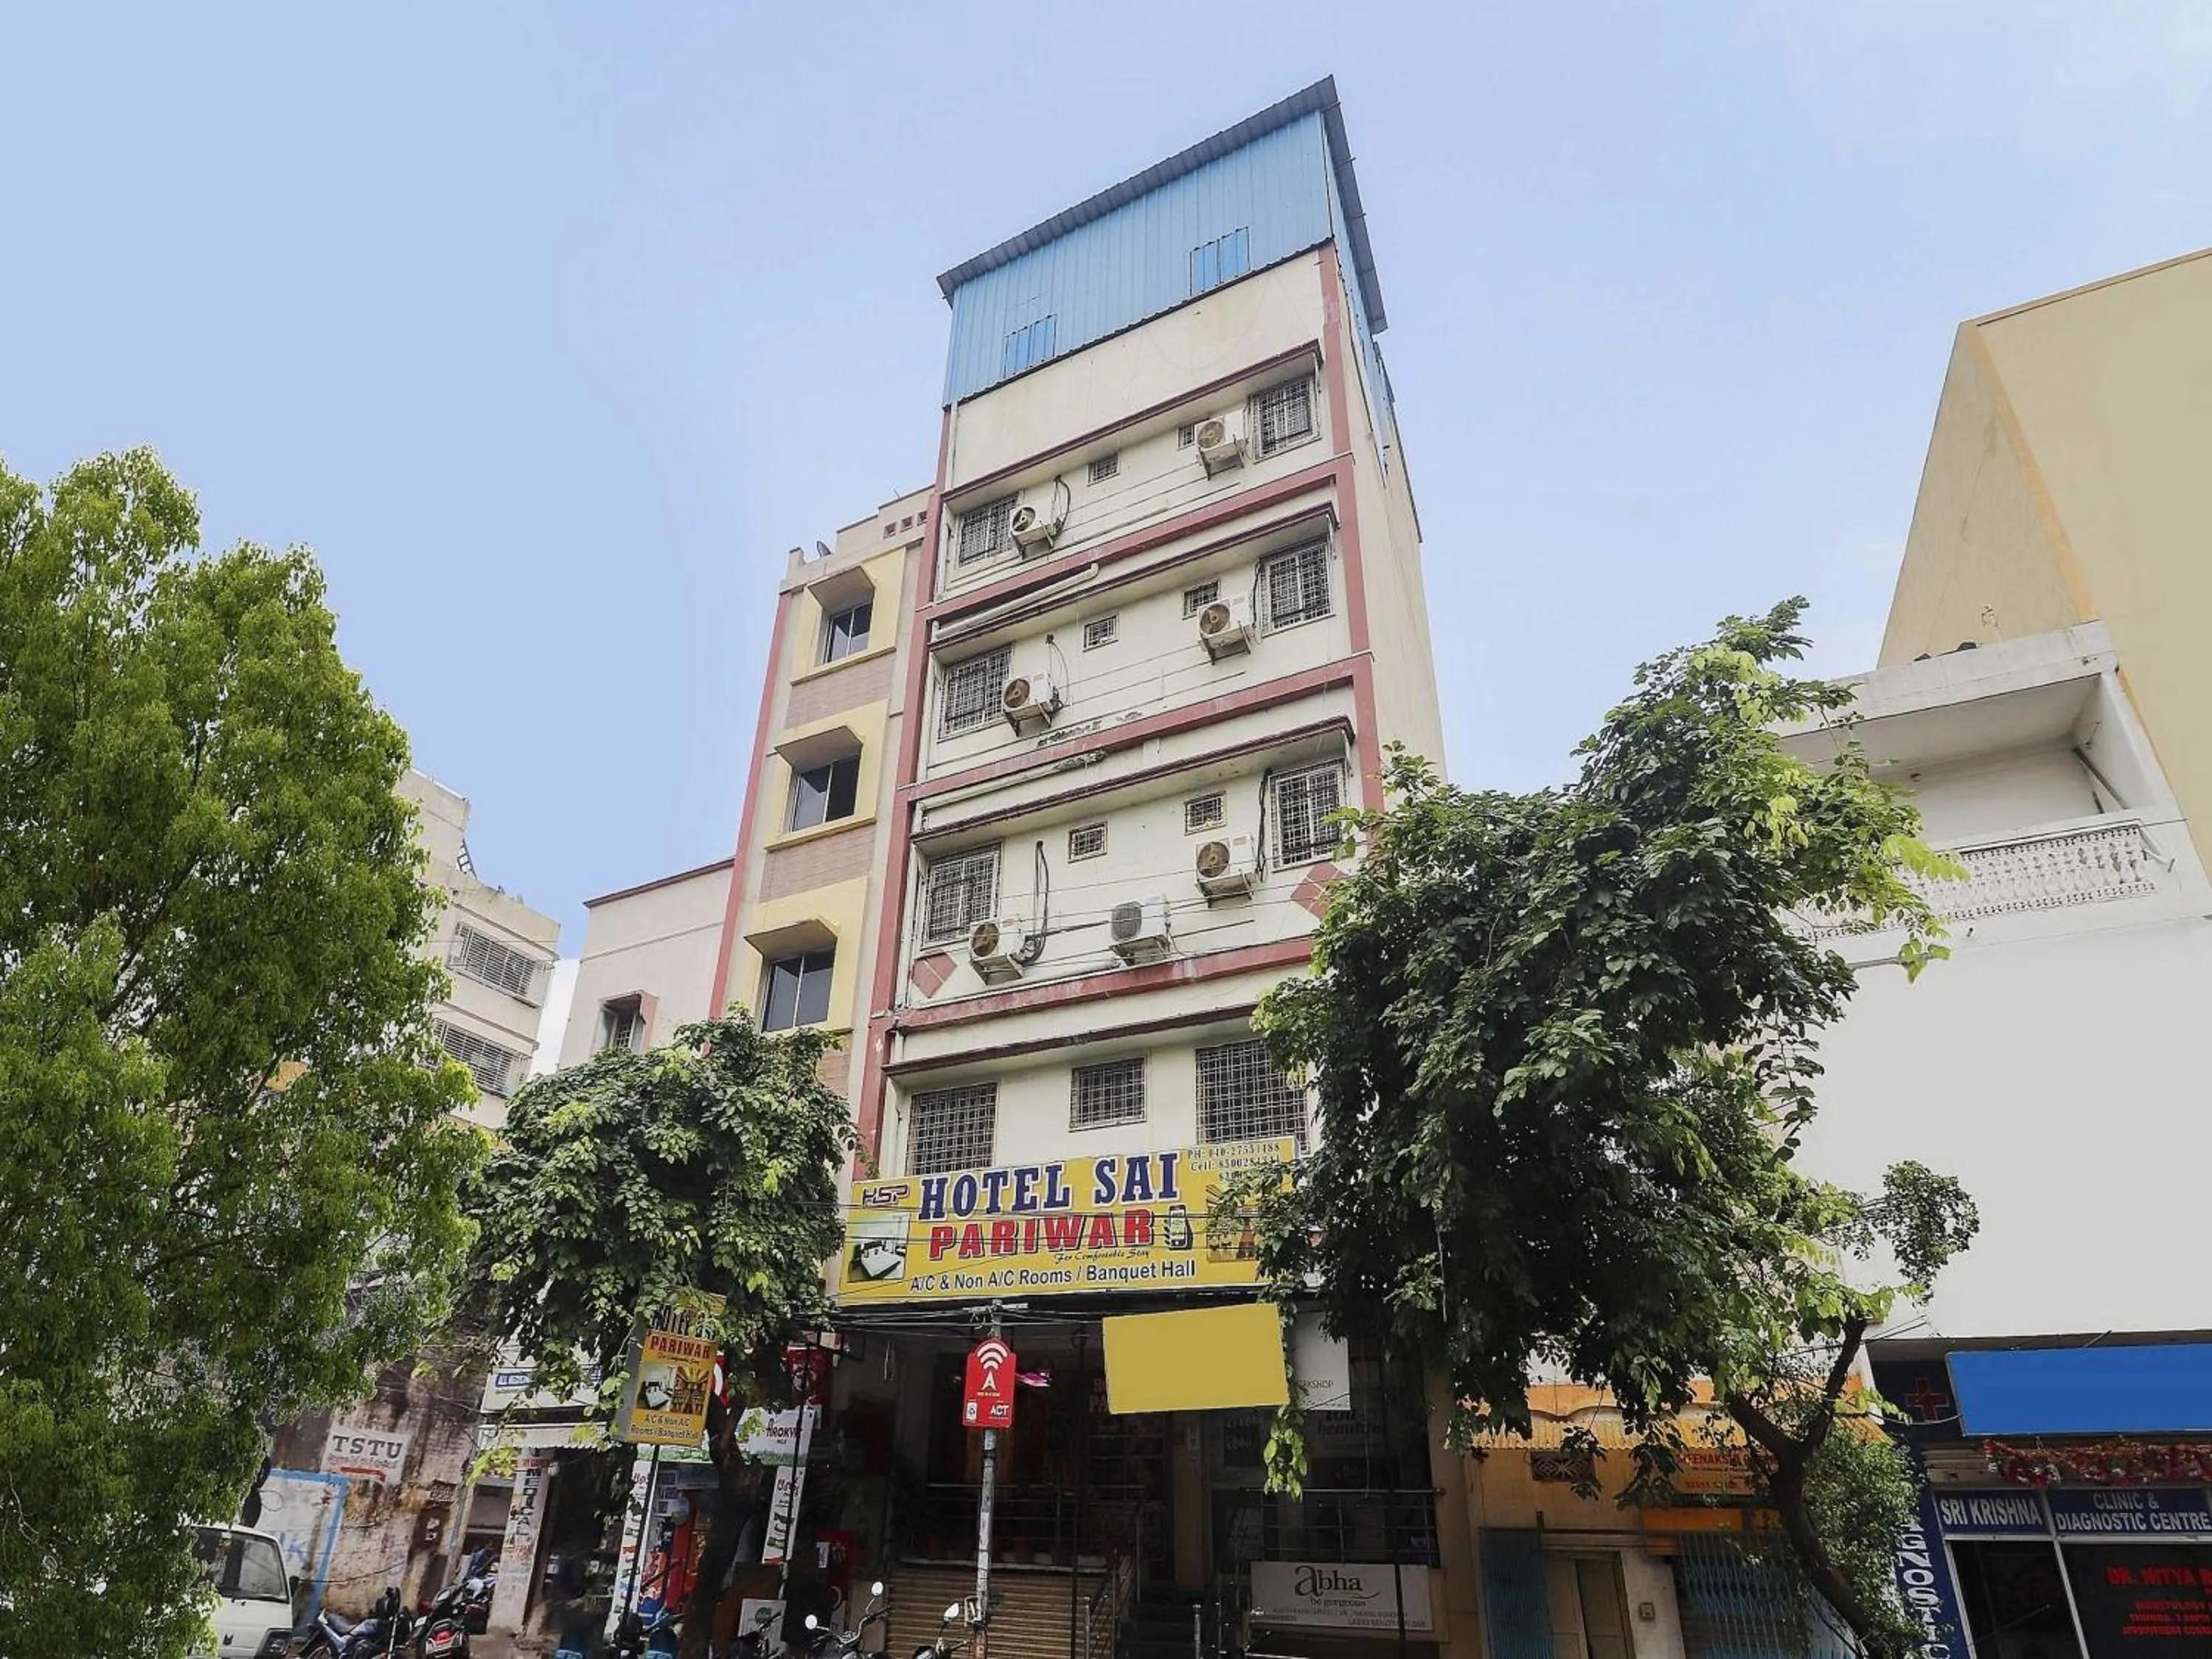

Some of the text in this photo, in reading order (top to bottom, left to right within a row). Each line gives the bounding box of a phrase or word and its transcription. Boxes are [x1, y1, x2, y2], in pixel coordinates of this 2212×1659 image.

[919, 1153, 1178, 1220] HOTEL SAI
[929, 1208, 1153, 1259] PARIWAR
[940, 1274, 950, 1290] &
[955, 1273, 983, 1290] Non
[988, 1270, 1015, 1287] A/C
[1020, 1268, 1072, 1285] Rooms
[1086, 1262, 1156, 1283] Banquet
[1161, 1259, 1195, 1277] Hall
[650, 1335, 712, 1359] PARIWAR
[990, 1405, 1009, 1415] ACT
[766, 1418, 803, 1438] AROKY
[332, 1435, 403, 1459] TSTU
[1941, 1498, 2042, 1526] SRI KRISHNA
[2093, 1492, 2160, 1510] CLINIC &
[2056, 1512, 2211, 1531] DIAGNOSTIC CENTRE
